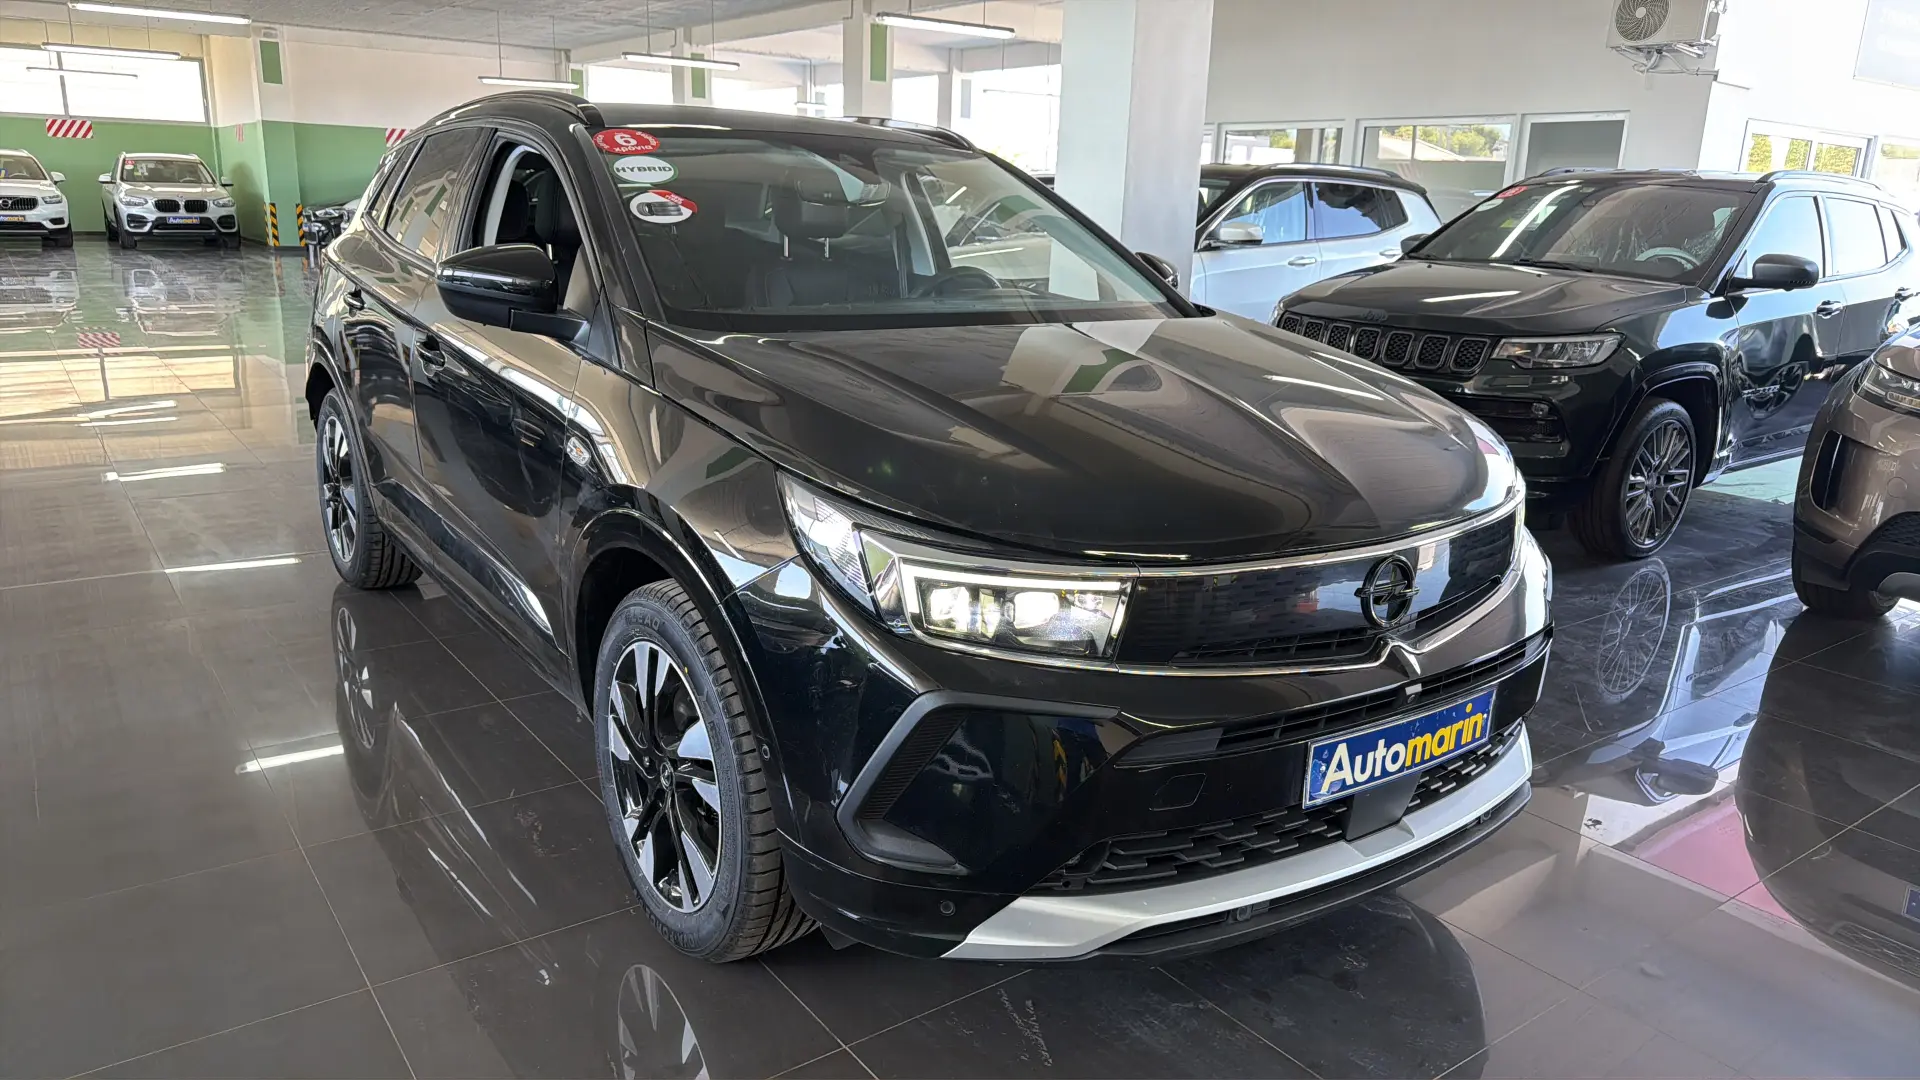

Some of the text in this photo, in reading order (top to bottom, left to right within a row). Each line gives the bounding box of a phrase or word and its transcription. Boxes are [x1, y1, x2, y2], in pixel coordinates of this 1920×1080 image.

[614, 133, 638, 146] 6
[613, 145, 653, 153] χρόνια
[1319, 702, 1484, 795] Automarin
